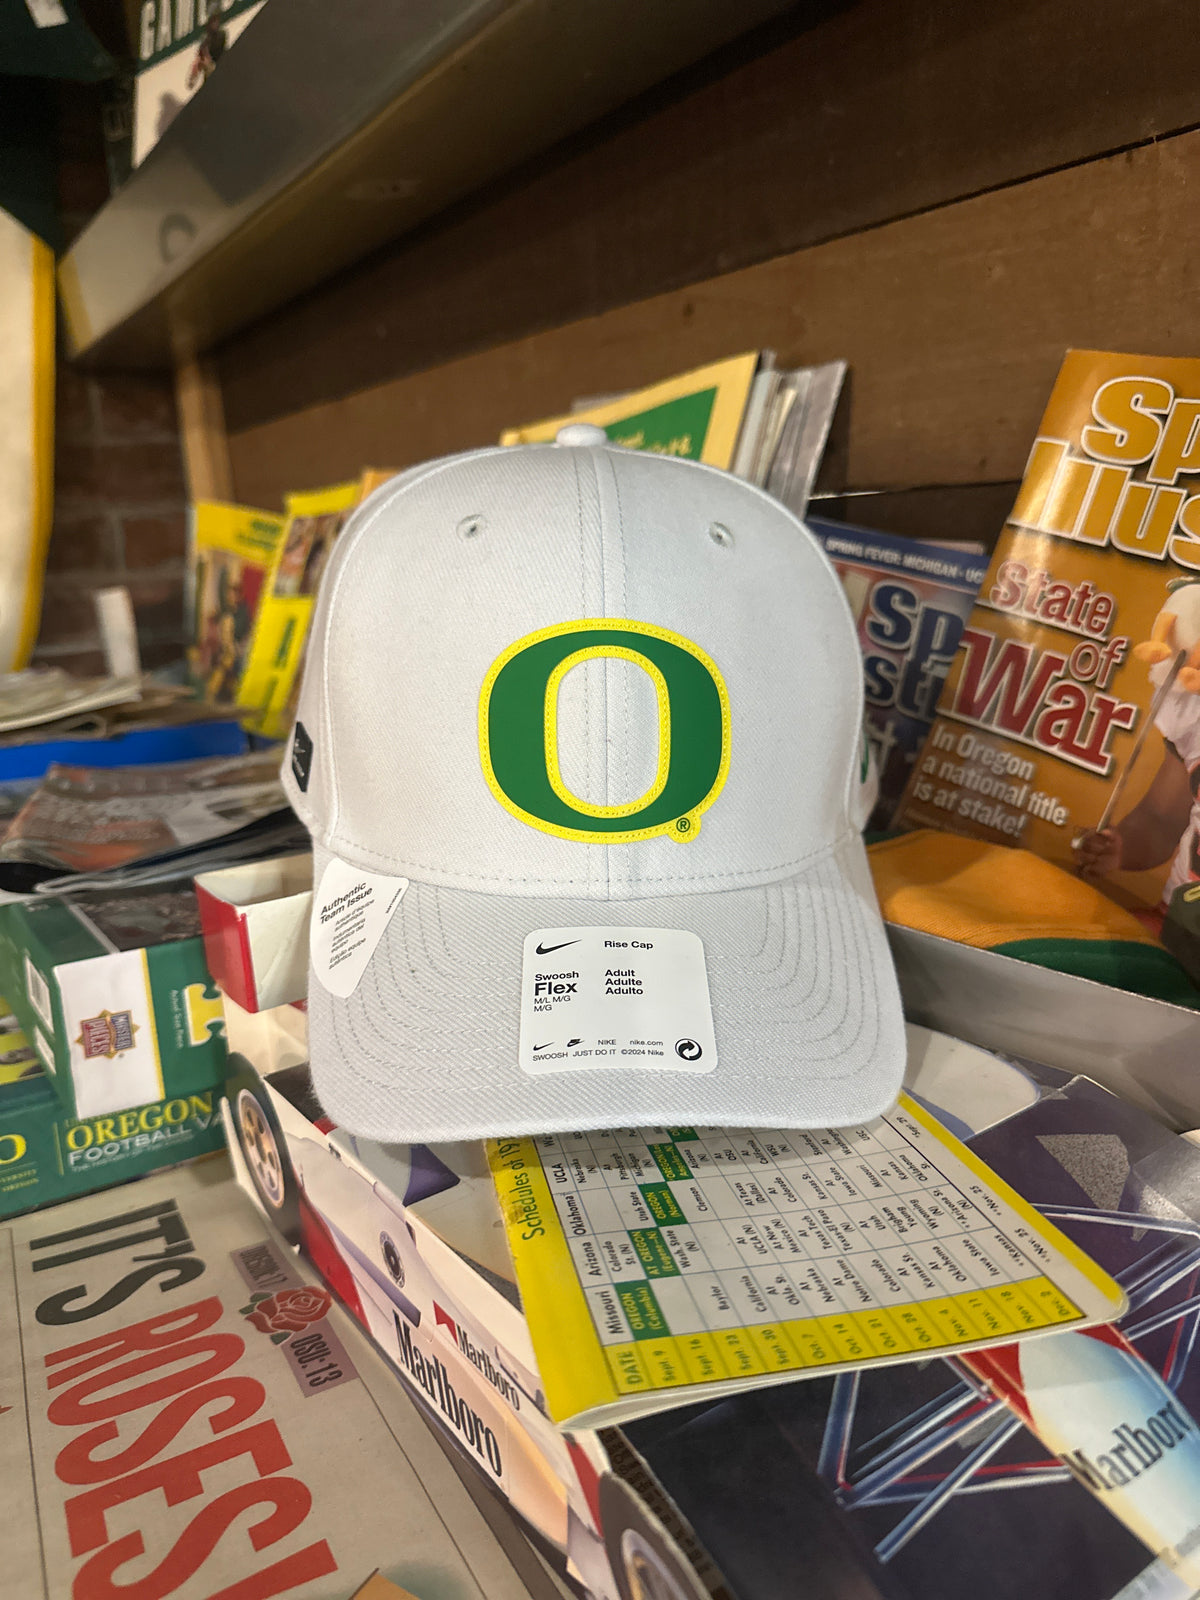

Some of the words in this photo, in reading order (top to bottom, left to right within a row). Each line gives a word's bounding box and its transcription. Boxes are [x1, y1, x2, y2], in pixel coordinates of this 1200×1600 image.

[990, 559, 1116, 637] State
[1069, 637, 1129, 690] of
[953, 628, 1138, 778] War
[932, 724, 955, 752] In
[956, 733, 1036, 781] Oregon
[922, 755, 938, 775] a
[938, 760, 1029, 809] national
[1026, 790, 1069, 826] title
[912, 776, 932, 802] is
[933, 788, 959, 812] at
[957, 796, 1028, 838] stake!
[320, 882, 367, 916] Authentic
[320, 905, 345, 924] Team
[347, 887, 373, 908] Issue
[604, 940, 628, 949] Rise
[631, 941, 654, 950] Cap
[534, 971, 580, 982] Swoosh
[605, 969, 636, 977] Adult
[605, 978, 642, 986] Adulte
[534, 982, 578, 996] Flex
[534, 996, 550, 1004] M/L
[552, 994, 572, 1003] M/G
[605, 987, 644, 995] Adulto
[533, 1004, 552, 1012] M/G
[532, 1052, 568, 1062] SWOOSH
[67, 1091, 213, 1150] OREGON
[68, 1127, 193, 1167] FOOTBALL
[502, 1158, 525, 1170] of
[550, 1162, 567, 1183] UCLA
[830, 1167, 844, 1180] State
[857, 1165, 882, 1187] Missouri
[888, 1162, 908, 1180] Kansas
[900, 1155, 928, 1181] Oklahoma
[630, 1192, 642, 1206] State
[690, 1187, 708, 1211] Clemson
[735, 1183, 748, 1198] Texas
[746, 1183, 767, 1203] (Dallas)
[774, 1177, 797, 1202] Colorado
[809, 1180, 828, 1200] Kansas
[842, 1182, 857, 1196] Iowa
[508, 1172, 545, 1240] Schedules
[566, 1196, 586, 1235] Oklahoma
[635, 1207, 648, 1221] Utah
[646, 1192, 666, 1218] OREGON
[818, 1210, 832, 1224] Paso
[897, 1207, 917, 1227] Young
[910, 1200, 938, 1229] Wyoming
[802, 1216, 818, 1230] Tech
[869, 1216, 886, 1230] Utah
[882, 1207, 908, 1233] Brigham
[667, 1230, 680, 1246] State
[750, 1236, 768, 1254] UCLA
[764, 1226, 777, 1240] New
[781, 1230, 801, 1253] Mexico
[815, 1231, 832, 1249] Texas
[582, 1242, 602, 1276] Arizona
[602, 1241, 622, 1272] Colorado
[632, 1232, 653, 1262] OREGON
[963, 1240, 982, 1256] State
[29, 1198, 206, 1326] IT'S
[646, 1266, 660, 1274] AT
[837, 1260, 855, 1280] Dame
[933, 1246, 967, 1282] Oklahoma
[980, 1258, 1000, 1276] Iowa
[807, 1268, 835, 1302] Nebraska
[872, 1259, 901, 1292] Colorado
[910, 1263, 935, 1288] Kansas
[711, 1286, 730, 1310] Baylor
[740, 1276, 767, 1312] California
[852, 1281, 872, 1302] Notre
[595, 1291, 624, 1334] Missouri
[621, 1293, 644, 1329] OREGON
[290, 1333, 332, 1369] OSU:
[305, 1362, 343, 1388] 13
[456, 1324, 521, 1411] Marlboro
[619, 1352, 643, 1384] DATE
[392, 1308, 502, 1478] Marlboro
[44, 1295, 339, 1600] ROSES!
